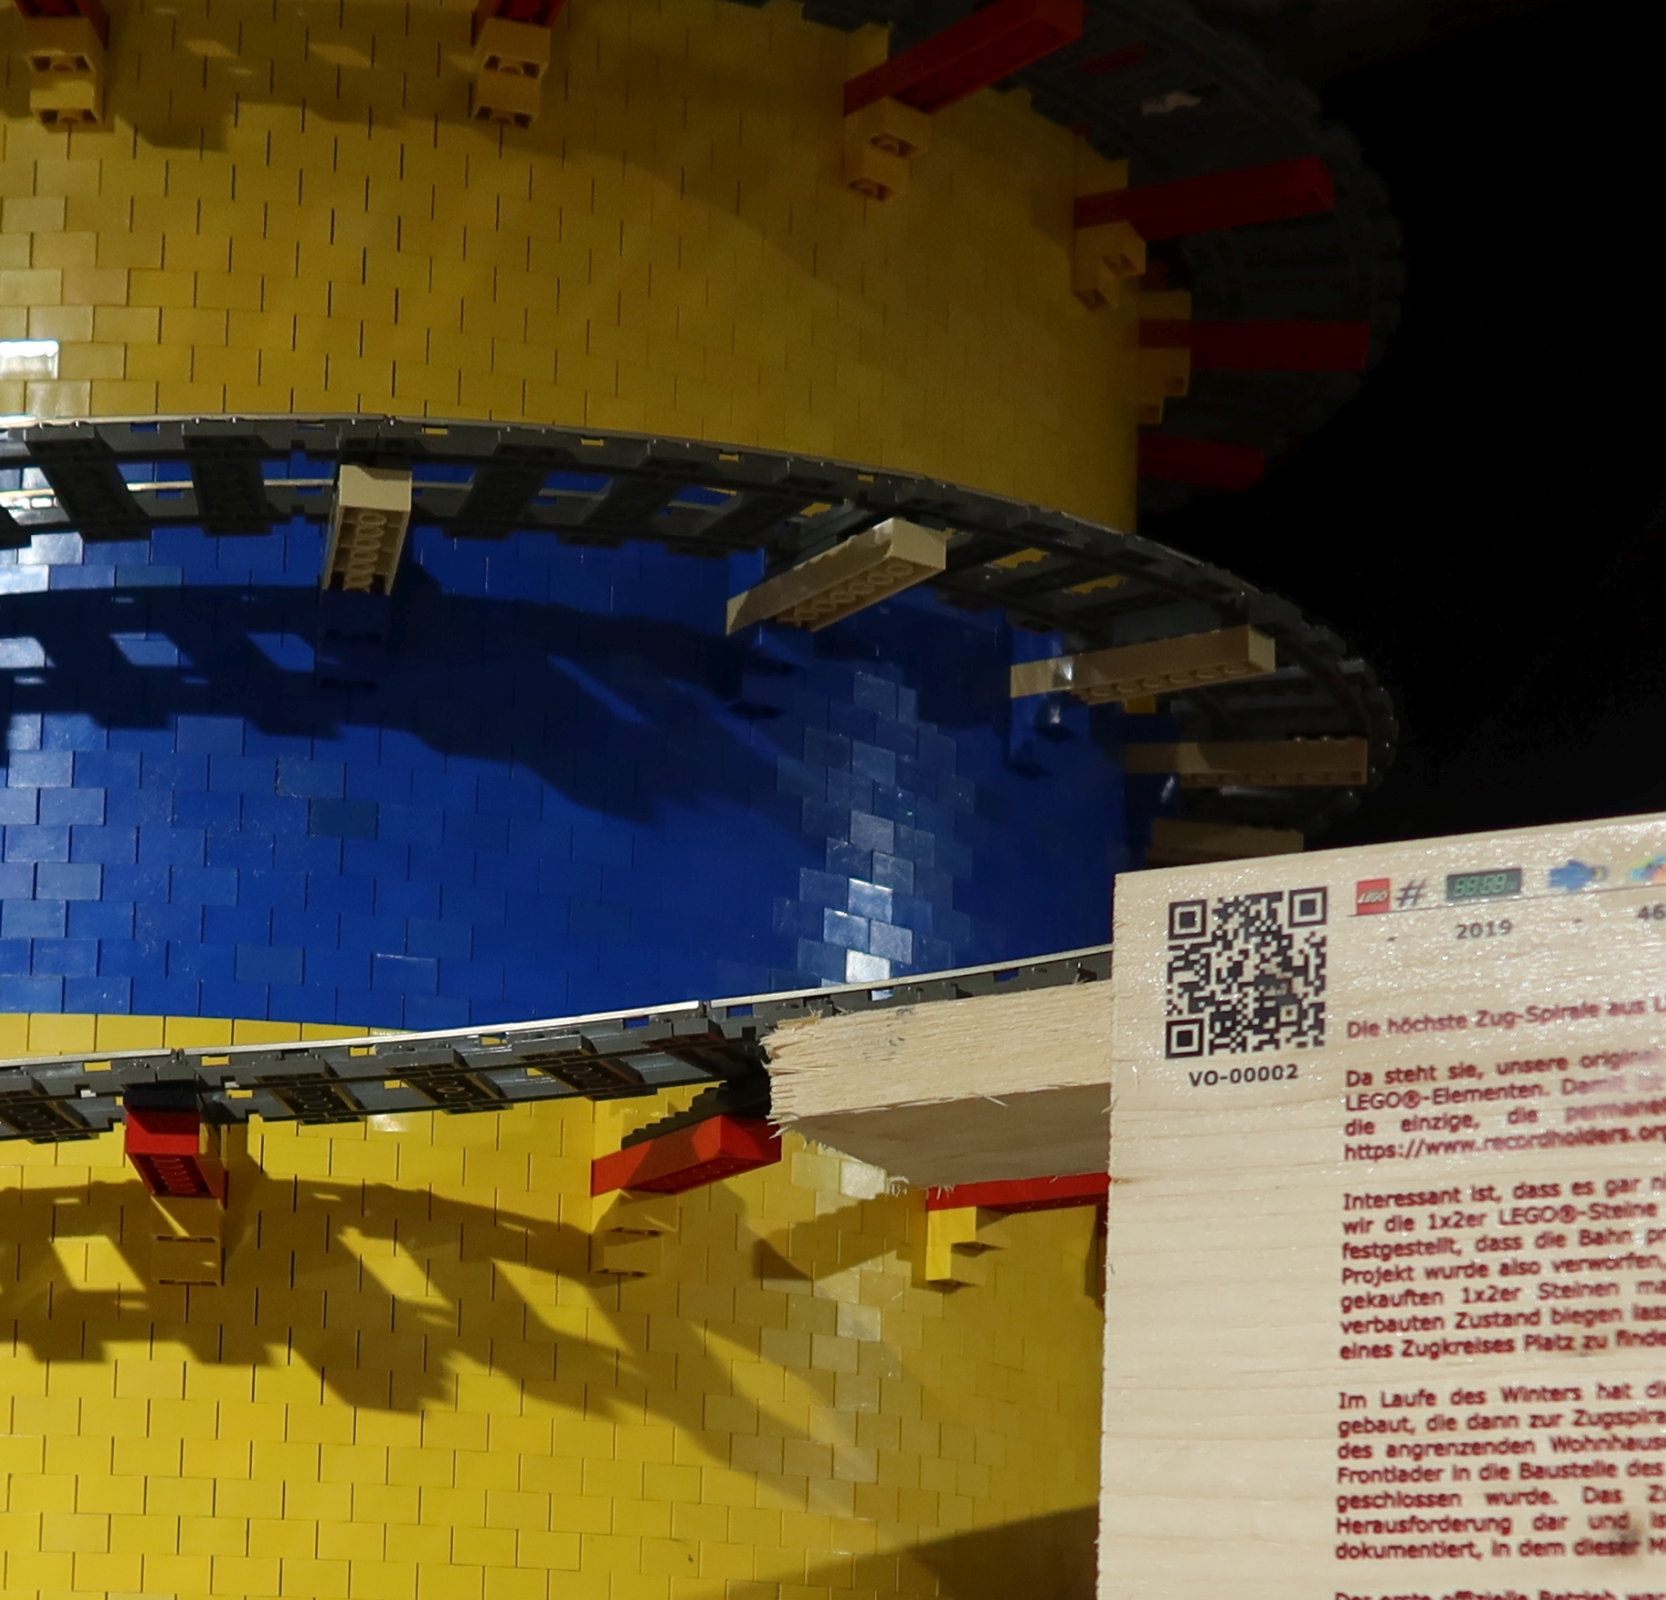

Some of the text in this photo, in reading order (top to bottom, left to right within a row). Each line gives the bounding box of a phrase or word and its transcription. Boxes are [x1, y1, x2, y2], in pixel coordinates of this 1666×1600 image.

[1456, 919, 1513, 940] 2019
[1346, 1000, 1645, 1039] Die höchste Zug-Spirale aus
[1188, 1062, 1299, 1089] VO-00002
[1345, 1069, 1373, 1086] Da
[1384, 1065, 1438, 1083] steht
[1447, 1061, 1484, 1080] sie,
[1495, 1056, 1570, 1075] unsere
[1345, 1084, 1549, 1110] LEGO®-Elementen.
[1343, 1106, 1538, 1136] die einzige, die
[1343, 1187, 1462, 1210] Interessant
[1470, 1184, 1502, 1203] ist,
[1512, 1182, 1562, 1200] dass
[1570, 1180, 1596, 1196] es
[1604, 1178, 1641, 1198] gar
[1342, 1217, 1373, 1235] wir
[1385, 1214, 1414, 1232] die
[1429, 1211, 1487, 1230] 1x2er
[1499, 1202, 1657, 1225] LEGO®-Steine
[1341, 1237, 1461, 1261] festgestellt,
[1475, 1235, 1523, 1252] dass
[1535, 1231, 1566, 1249] die
[1579, 1228, 1631, 1247] Bahn
[1341, 1266, 1414, 1286] Projekt
[1425, 1261, 1488, 1280] wurde
[1499, 1259, 1541, 1277] also
[1340, 1282, 1618, 1313] gekauften 1x2er Steinen
[1339, 1316, 1444, 1334] verbauten
[1455, 1309, 1541, 1329] Zustand
[1339, 1342, 1394, 1359] eines
[1400, 1338, 1516, 1360] Zugkreises
[1523, 1334, 1577, 1352] Platz
[1338, 1391, 1367, 1410] Im
[1380, 1388, 1437, 1408] Laufe
[1449, 1388, 1487, 1406] des
[1499, 1385, 1583, 1403] Winters
[1337, 1416, 1415, 1438] gebaut,
[1426, 1414, 1457, 1432] die
[1467, 1413, 1519, 1430] dann
[1529, 1413, 1563, 1429] zur
[1336, 1442, 1372, 1460] des
[1386, 1439, 1535, 1461] angrenzenden
[1337, 1461, 1616, 1484] Frontlader in die Baustelle
[1335, 1485, 1623, 1513] geschlossen wurde. Das
[1336, 1516, 1512, 1536] Herausforderung
[1533, 1513, 1569, 1531] dar
[1334, 1539, 1566, 1560] dokumentiert, dem
